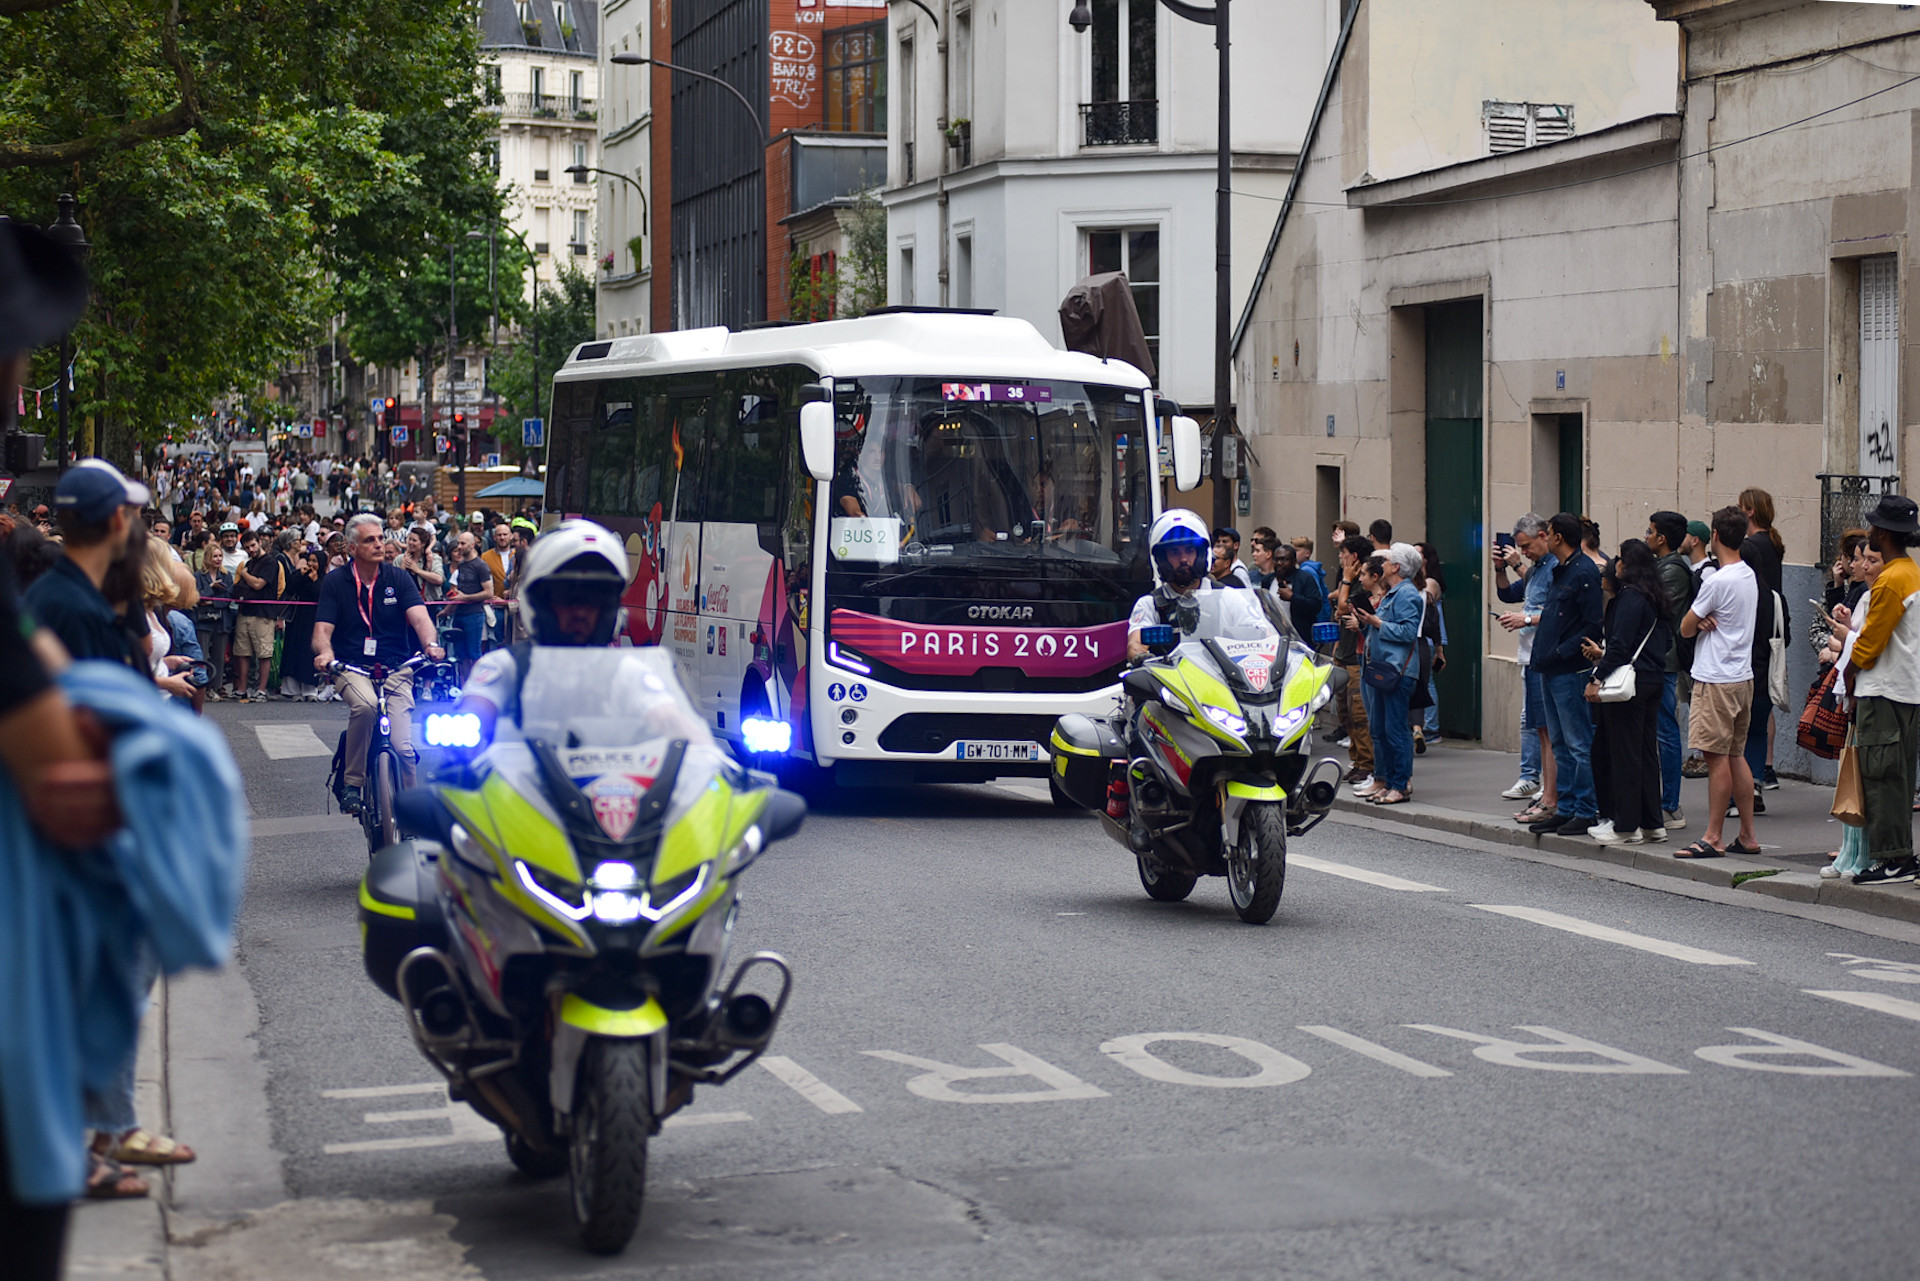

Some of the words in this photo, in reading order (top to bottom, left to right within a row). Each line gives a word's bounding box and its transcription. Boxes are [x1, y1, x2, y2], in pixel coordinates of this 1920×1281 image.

[1007, 386, 1024, 399] 35
[843, 529, 873, 544] BUS
[877, 530, 886, 544] 2
[967, 605, 1034, 620] OTOKAR
[1014, 633, 1099, 659] 2024
[1226, 642, 1262, 651] POLICE
[1247, 668, 1267, 678] CRS
[967, 744, 1028, 758] GW-701-MM
[569, 753, 633, 765] POLICE
